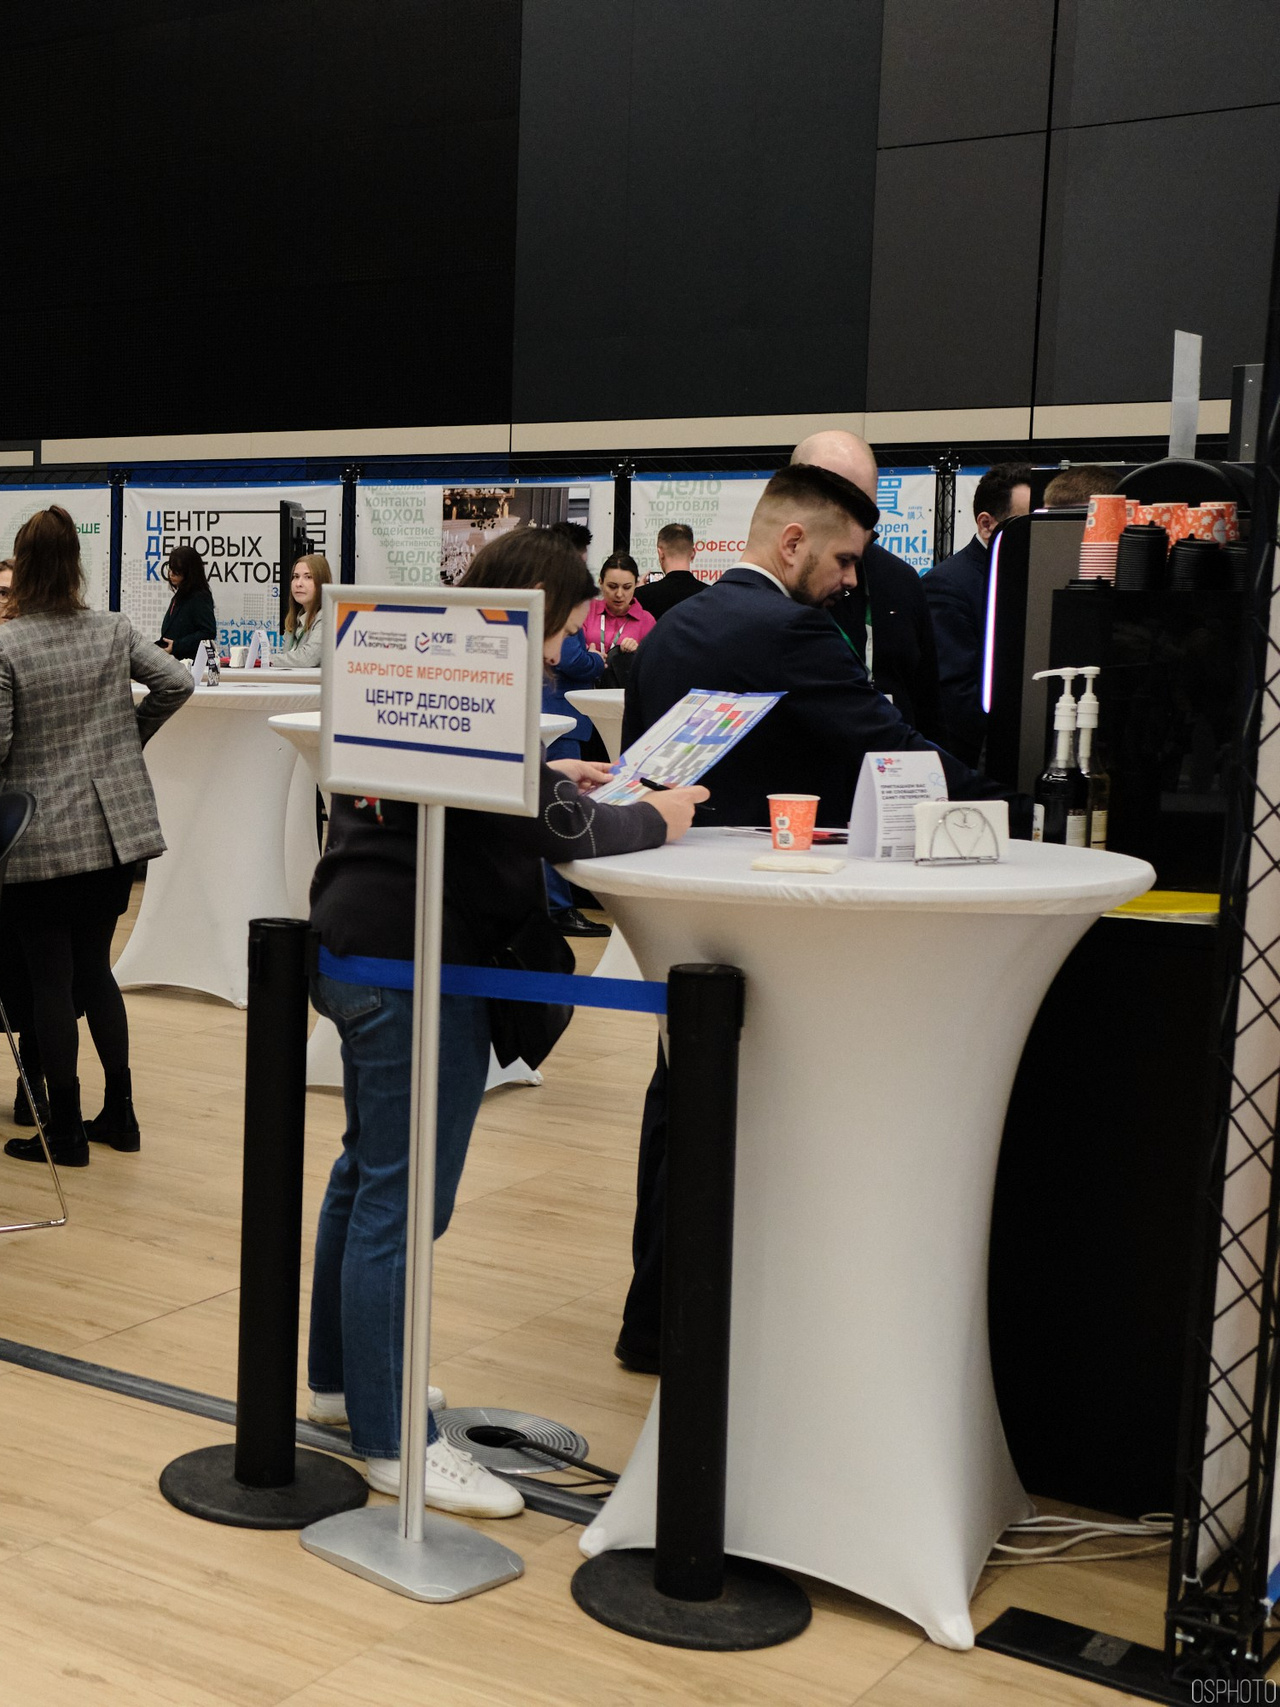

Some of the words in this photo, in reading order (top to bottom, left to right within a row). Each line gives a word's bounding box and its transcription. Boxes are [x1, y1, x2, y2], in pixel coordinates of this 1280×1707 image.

[365, 497, 426, 507] контакты
[649, 500, 720, 515] торговля
[146, 510, 220, 535] ЦЕНТР
[371, 509, 424, 523] доход
[372, 525, 435, 536] содействие
[353, 630, 368, 648] IX
[347, 661, 413, 678] ЗАКРЫТОЕ
[417, 666, 514, 686] МЕРОПРИЯТИЕ
[366, 689, 414, 706] ЦЕНТР
[417, 692, 495, 714] ДЕЛОВЫХ
[377, 710, 471, 732] КОНТАКТОВ
